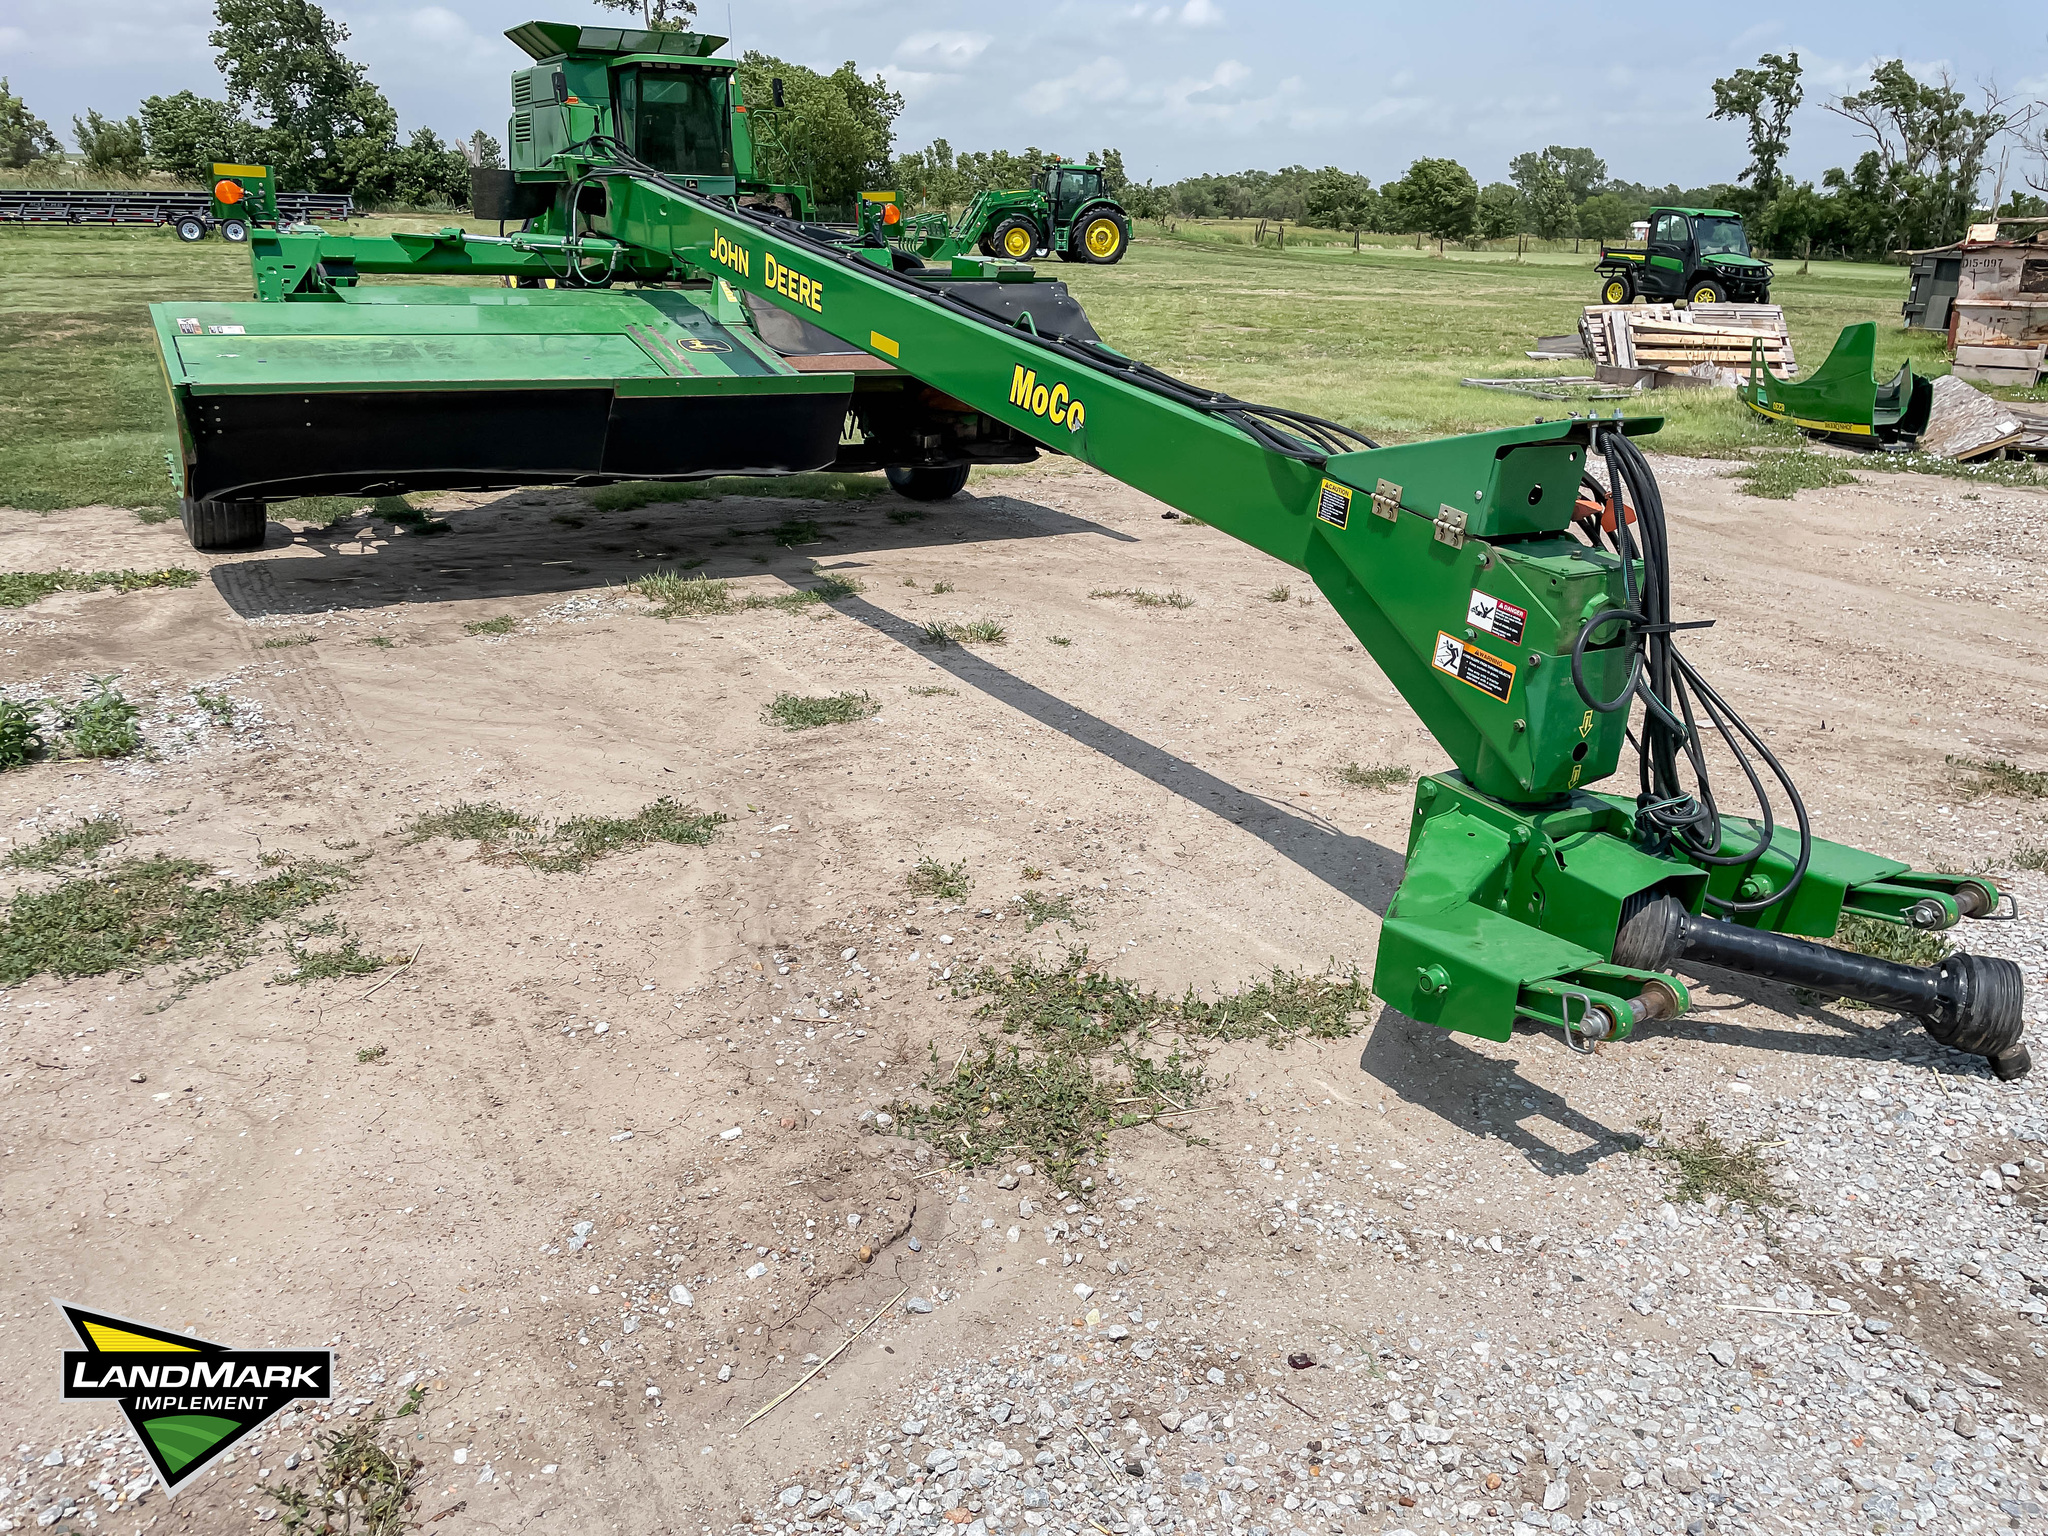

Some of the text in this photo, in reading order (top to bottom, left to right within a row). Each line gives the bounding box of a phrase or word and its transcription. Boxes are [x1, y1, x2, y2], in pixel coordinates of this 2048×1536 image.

[709, 228, 823, 315] JOHN DEERE
[1008, 362, 1086, 434] MoCo
[1328, 483, 1350, 497] CAUTION
[1503, 604, 1524, 617] DANGER
[1479, 652, 1503, 667] WARNING
